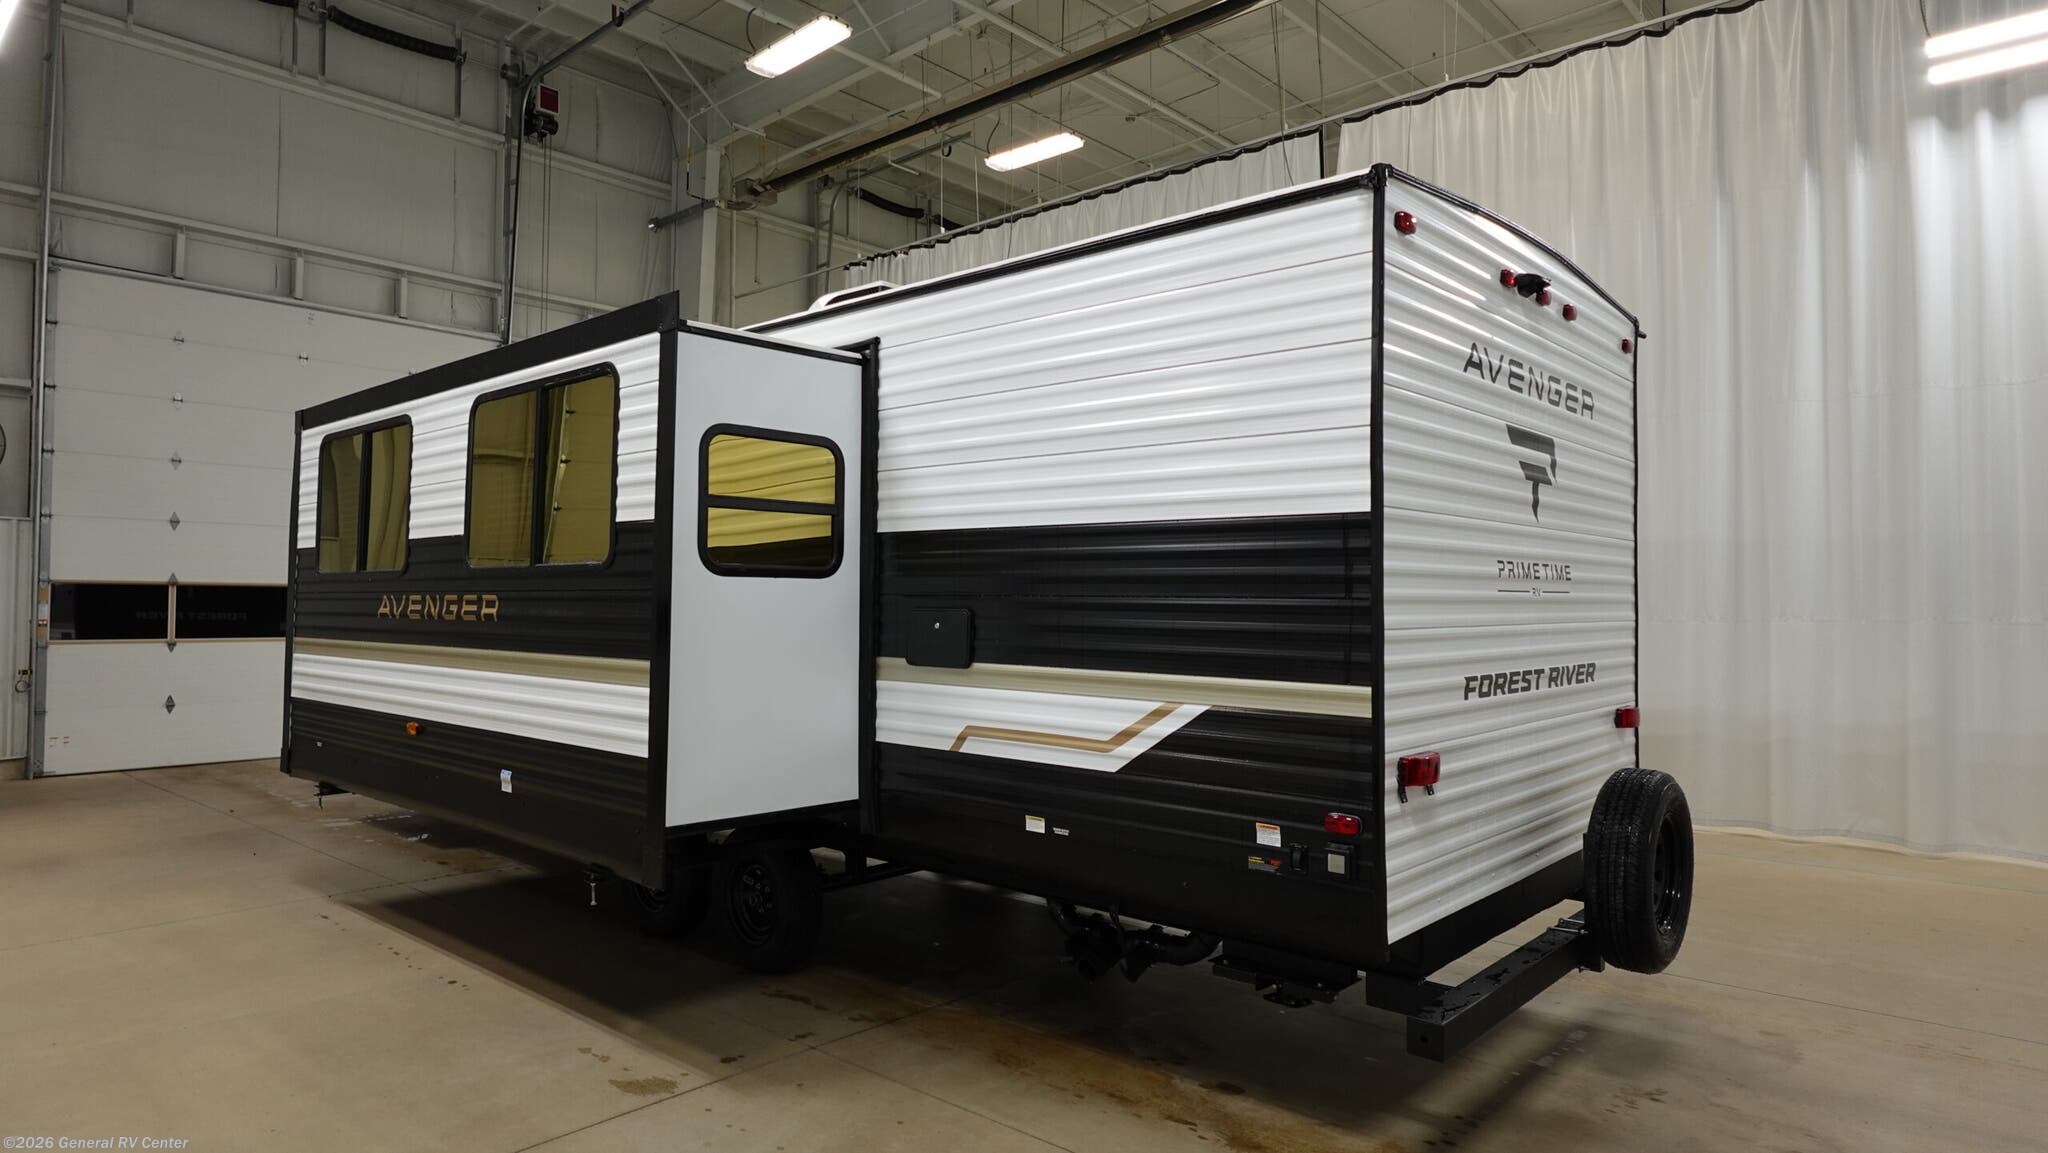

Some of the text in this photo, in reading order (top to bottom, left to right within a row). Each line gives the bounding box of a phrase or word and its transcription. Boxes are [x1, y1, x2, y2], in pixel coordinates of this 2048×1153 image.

[1463, 342, 1595, 420] AVENGER
[377, 594, 499, 622] AVENGER
[1464, 662, 1597, 701] FOREST RIVER
